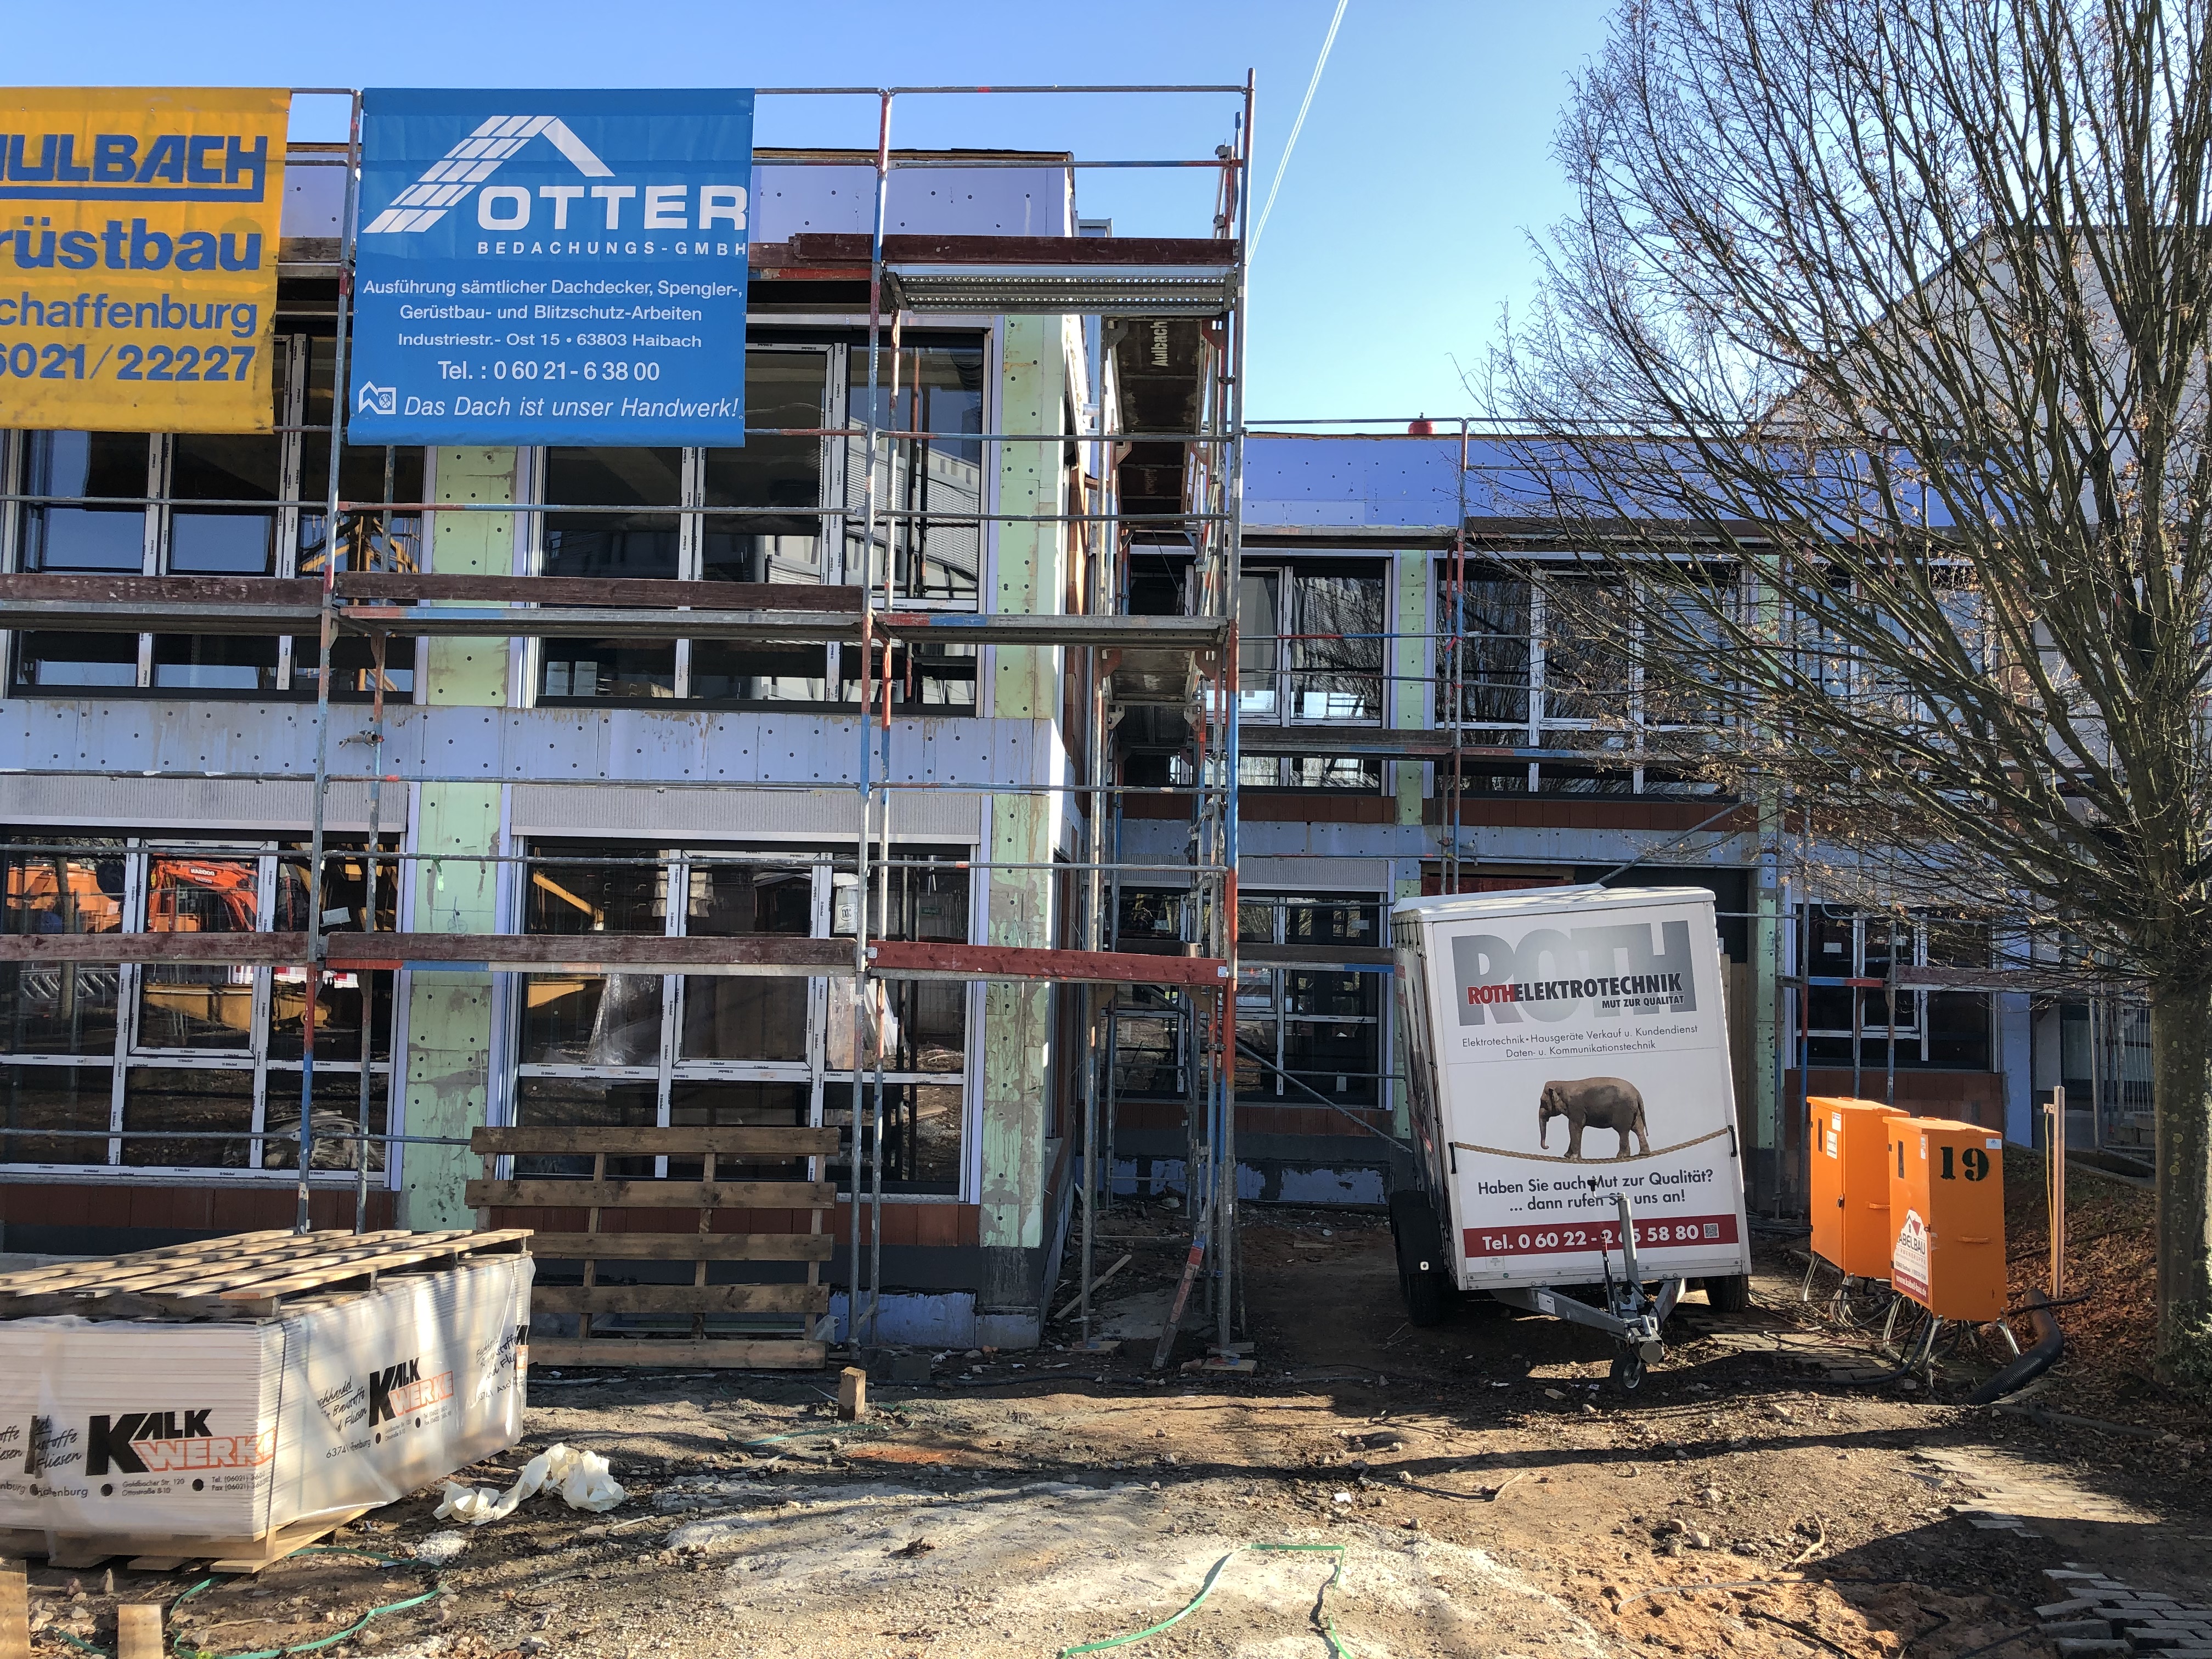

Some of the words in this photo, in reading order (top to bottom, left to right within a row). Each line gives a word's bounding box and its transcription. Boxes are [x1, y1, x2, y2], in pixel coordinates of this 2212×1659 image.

[0, 134, 268, 184] ULBACH
[478, 185, 747, 230] OTTER
[478, 242, 746, 255] BEDACHUNGS-GMBH
[363, 280, 455, 296] Ausführung
[462, 280, 546, 293] sämtlicher
[552, 280, 652, 296] Dachdecker,
[658, 280, 742, 298] Spengler-,
[400, 305, 491, 319] Gerüstbau-
[498, 306, 527, 318] und
[535, 305, 701, 320] Blitzschutz-Arbeiten
[399, 334, 500, 345] Industriestr.-
[507, 334, 535, 345] Ost
[541, 334, 560, 345] 15
[577, 334, 627, 346] 63803
[633, 334, 701, 347] Haibach
[1150, 321, 1168, 366] Aulbach
[0, 343, 256, 381] 021/22227
[438, 361, 472, 379] Tel.
[494, 361, 506, 379] 0
[513, 361, 538, 379] 60
[544, 362, 565, 379] 21
[584, 362, 596, 380] 6
[602, 362, 628, 380] 38
[634, 363, 659, 380] 00
[404, 397, 445, 415] Das
[454, 397, 510, 415] Dach
[520, 397, 544, 416] ist
[552, 402, 613, 416] unser
[622, 398, 738, 417] Handwerk!
[1451, 920, 1697, 1026] ROTH
[1602, 1000, 1621, 1009] MUT
[1623, 998, 1641, 1008] ZUR
[1643, 995, 1684, 1006] QUALITÄT
[1587, 1028, 1622, 1040] Verkauf
[1635, 1025, 1698, 1036] Kundendienst
[1506, 1048, 1536, 1058] Daten-
[1550, 1040, 1656, 1055] Kommunikationstechnik
[1940, 1146, 1989, 1182] 19
[1478, 1181, 1523, 1195] Haben
[1528, 1179, 1549, 1192] Sie
[1553, 1175, 1586, 1190] auch
[1622, 1177, 1644, 1187] zur
[1649, 1169, 1713, 1186] Qualität?
[1528, 1196, 1562, 1210] dann
[1568, 1193, 1604, 1207] rufen
[1634, 1193, 1658, 1204] uns
[1663, 1189, 1686, 1203] an!
[1482, 1235, 1514, 1250] Tel.
[1519, 1234, 1530, 1249] 0
[1536, 1233, 1559, 1248] 60
[1563, 1231, 1587, 1246] 22
[1647, 1226, 1670, 1242] 58
[1675, 1224, 1699, 1240] 80
[1898, 1233, 1926, 1255] ABELBAU
[369, 1357, 421, 1427] KALK
[85, 1409, 213, 1476] KALK
